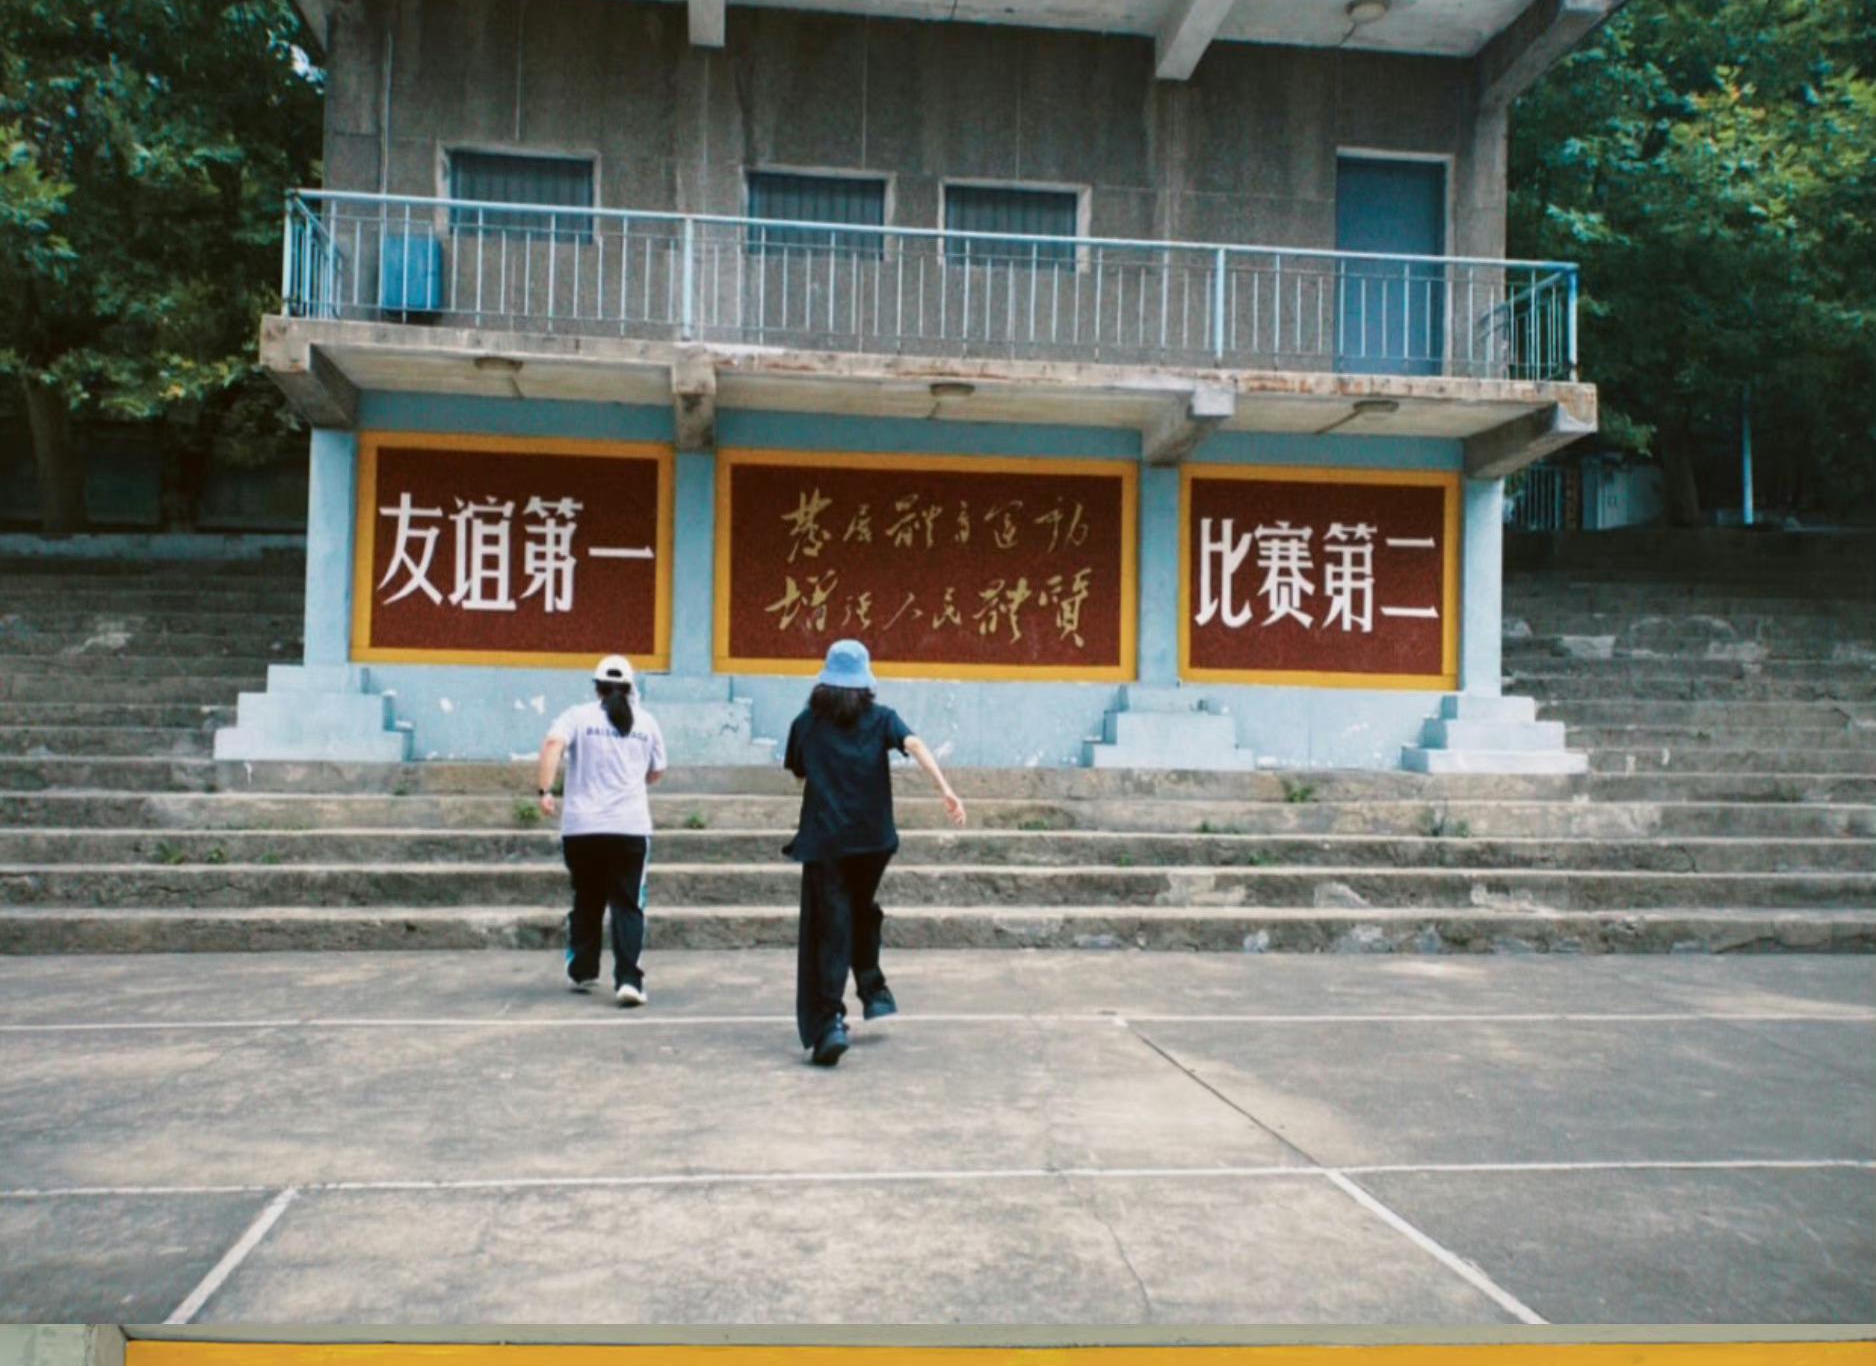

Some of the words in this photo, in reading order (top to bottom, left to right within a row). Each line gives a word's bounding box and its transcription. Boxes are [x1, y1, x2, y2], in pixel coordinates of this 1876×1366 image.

[376, 492, 655, 614] 友谊第一
[1195, 517, 1439, 633] 比赛第二
